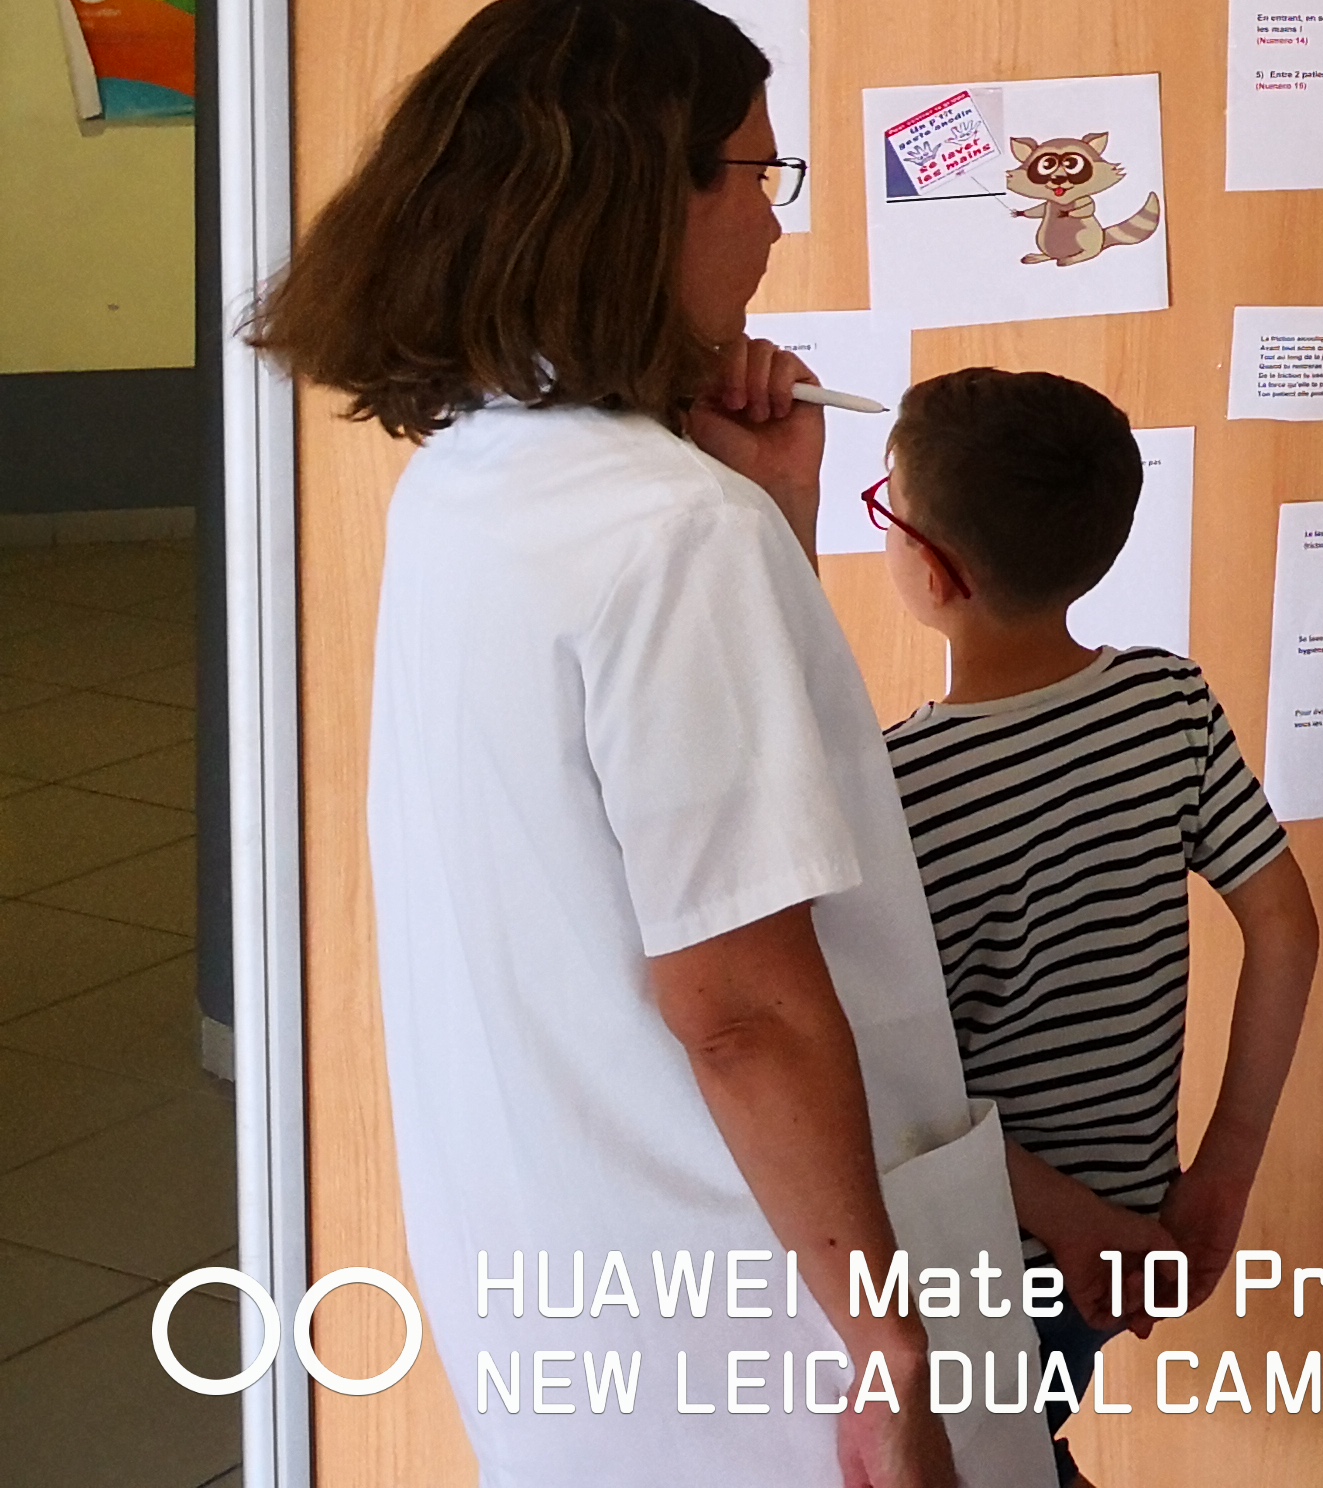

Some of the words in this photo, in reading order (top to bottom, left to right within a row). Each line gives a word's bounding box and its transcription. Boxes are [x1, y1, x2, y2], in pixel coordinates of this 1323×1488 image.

[935, 109, 972, 130] anodin
[942, 138, 980, 162] laver
[917, 169, 941, 185] les
[946, 143, 990, 170] mains
